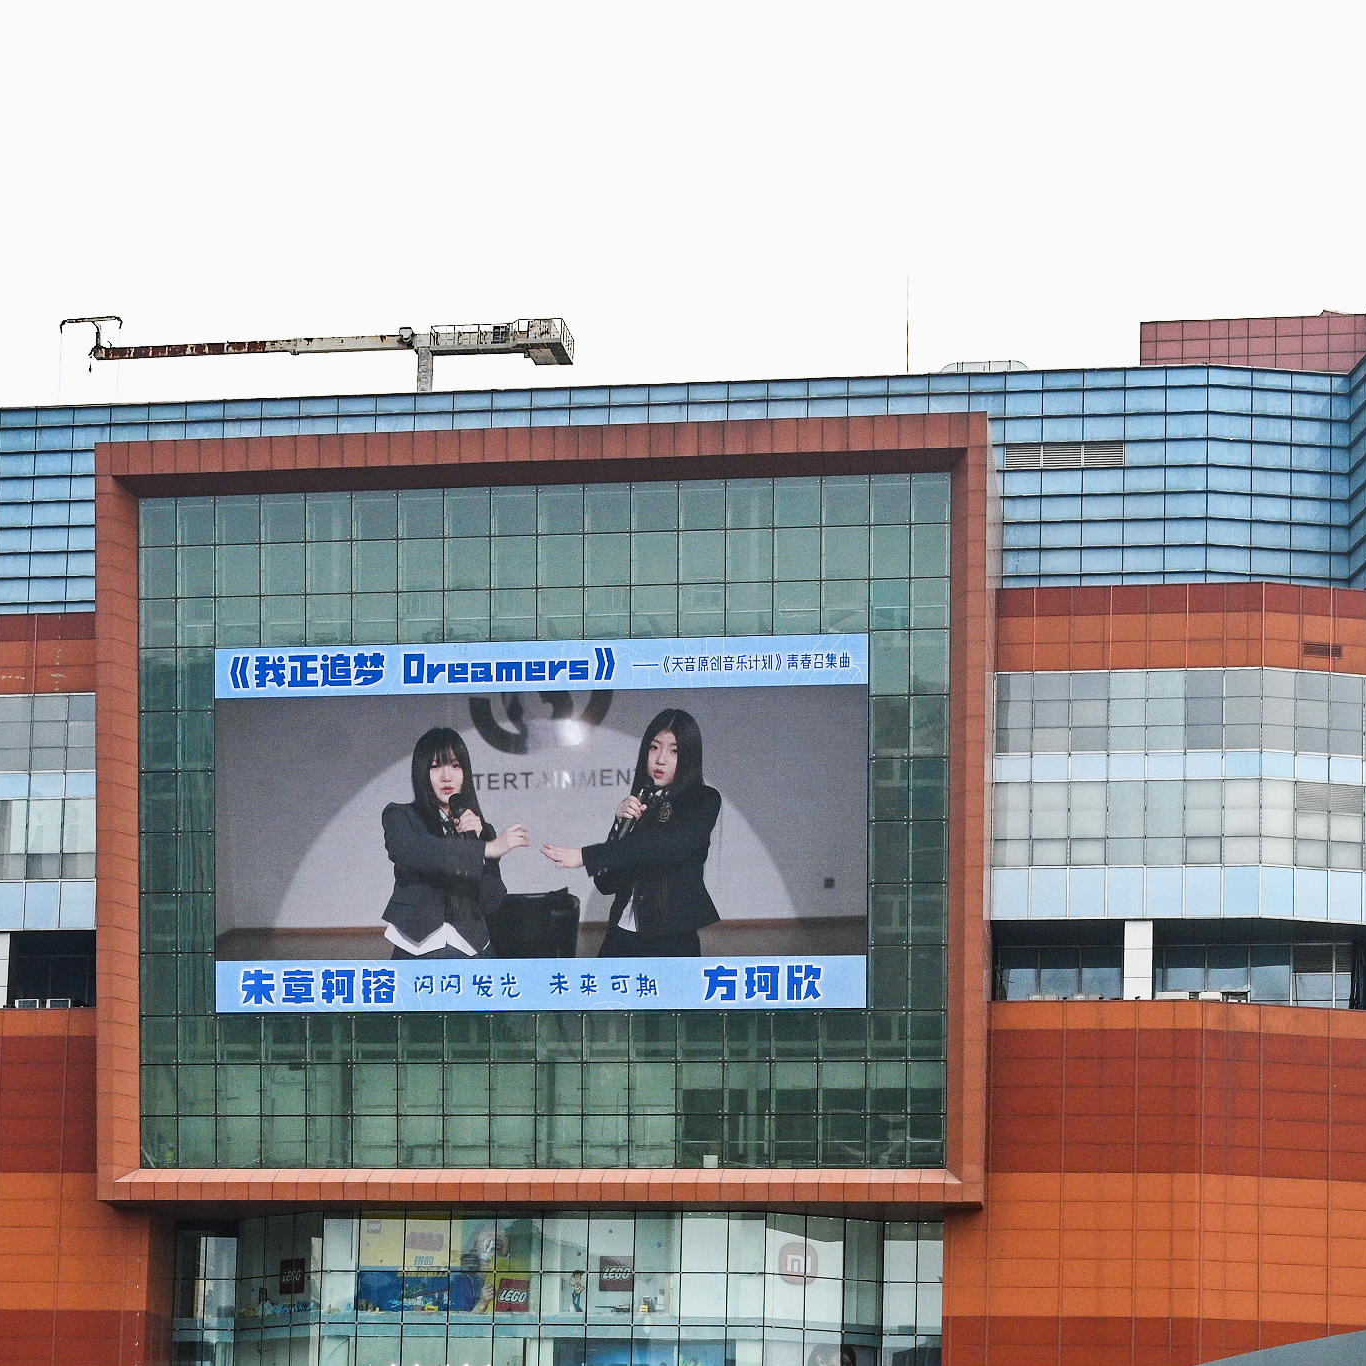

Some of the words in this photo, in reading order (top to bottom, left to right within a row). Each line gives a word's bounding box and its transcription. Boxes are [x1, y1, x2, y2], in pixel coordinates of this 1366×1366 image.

[240, 968, 397, 1005] 朱章轲镕
[703, 963, 822, 1001] 方珂欣
[601, 1265, 632, 1281] LEGO
[499, 1288, 528, 1304] LEGO
